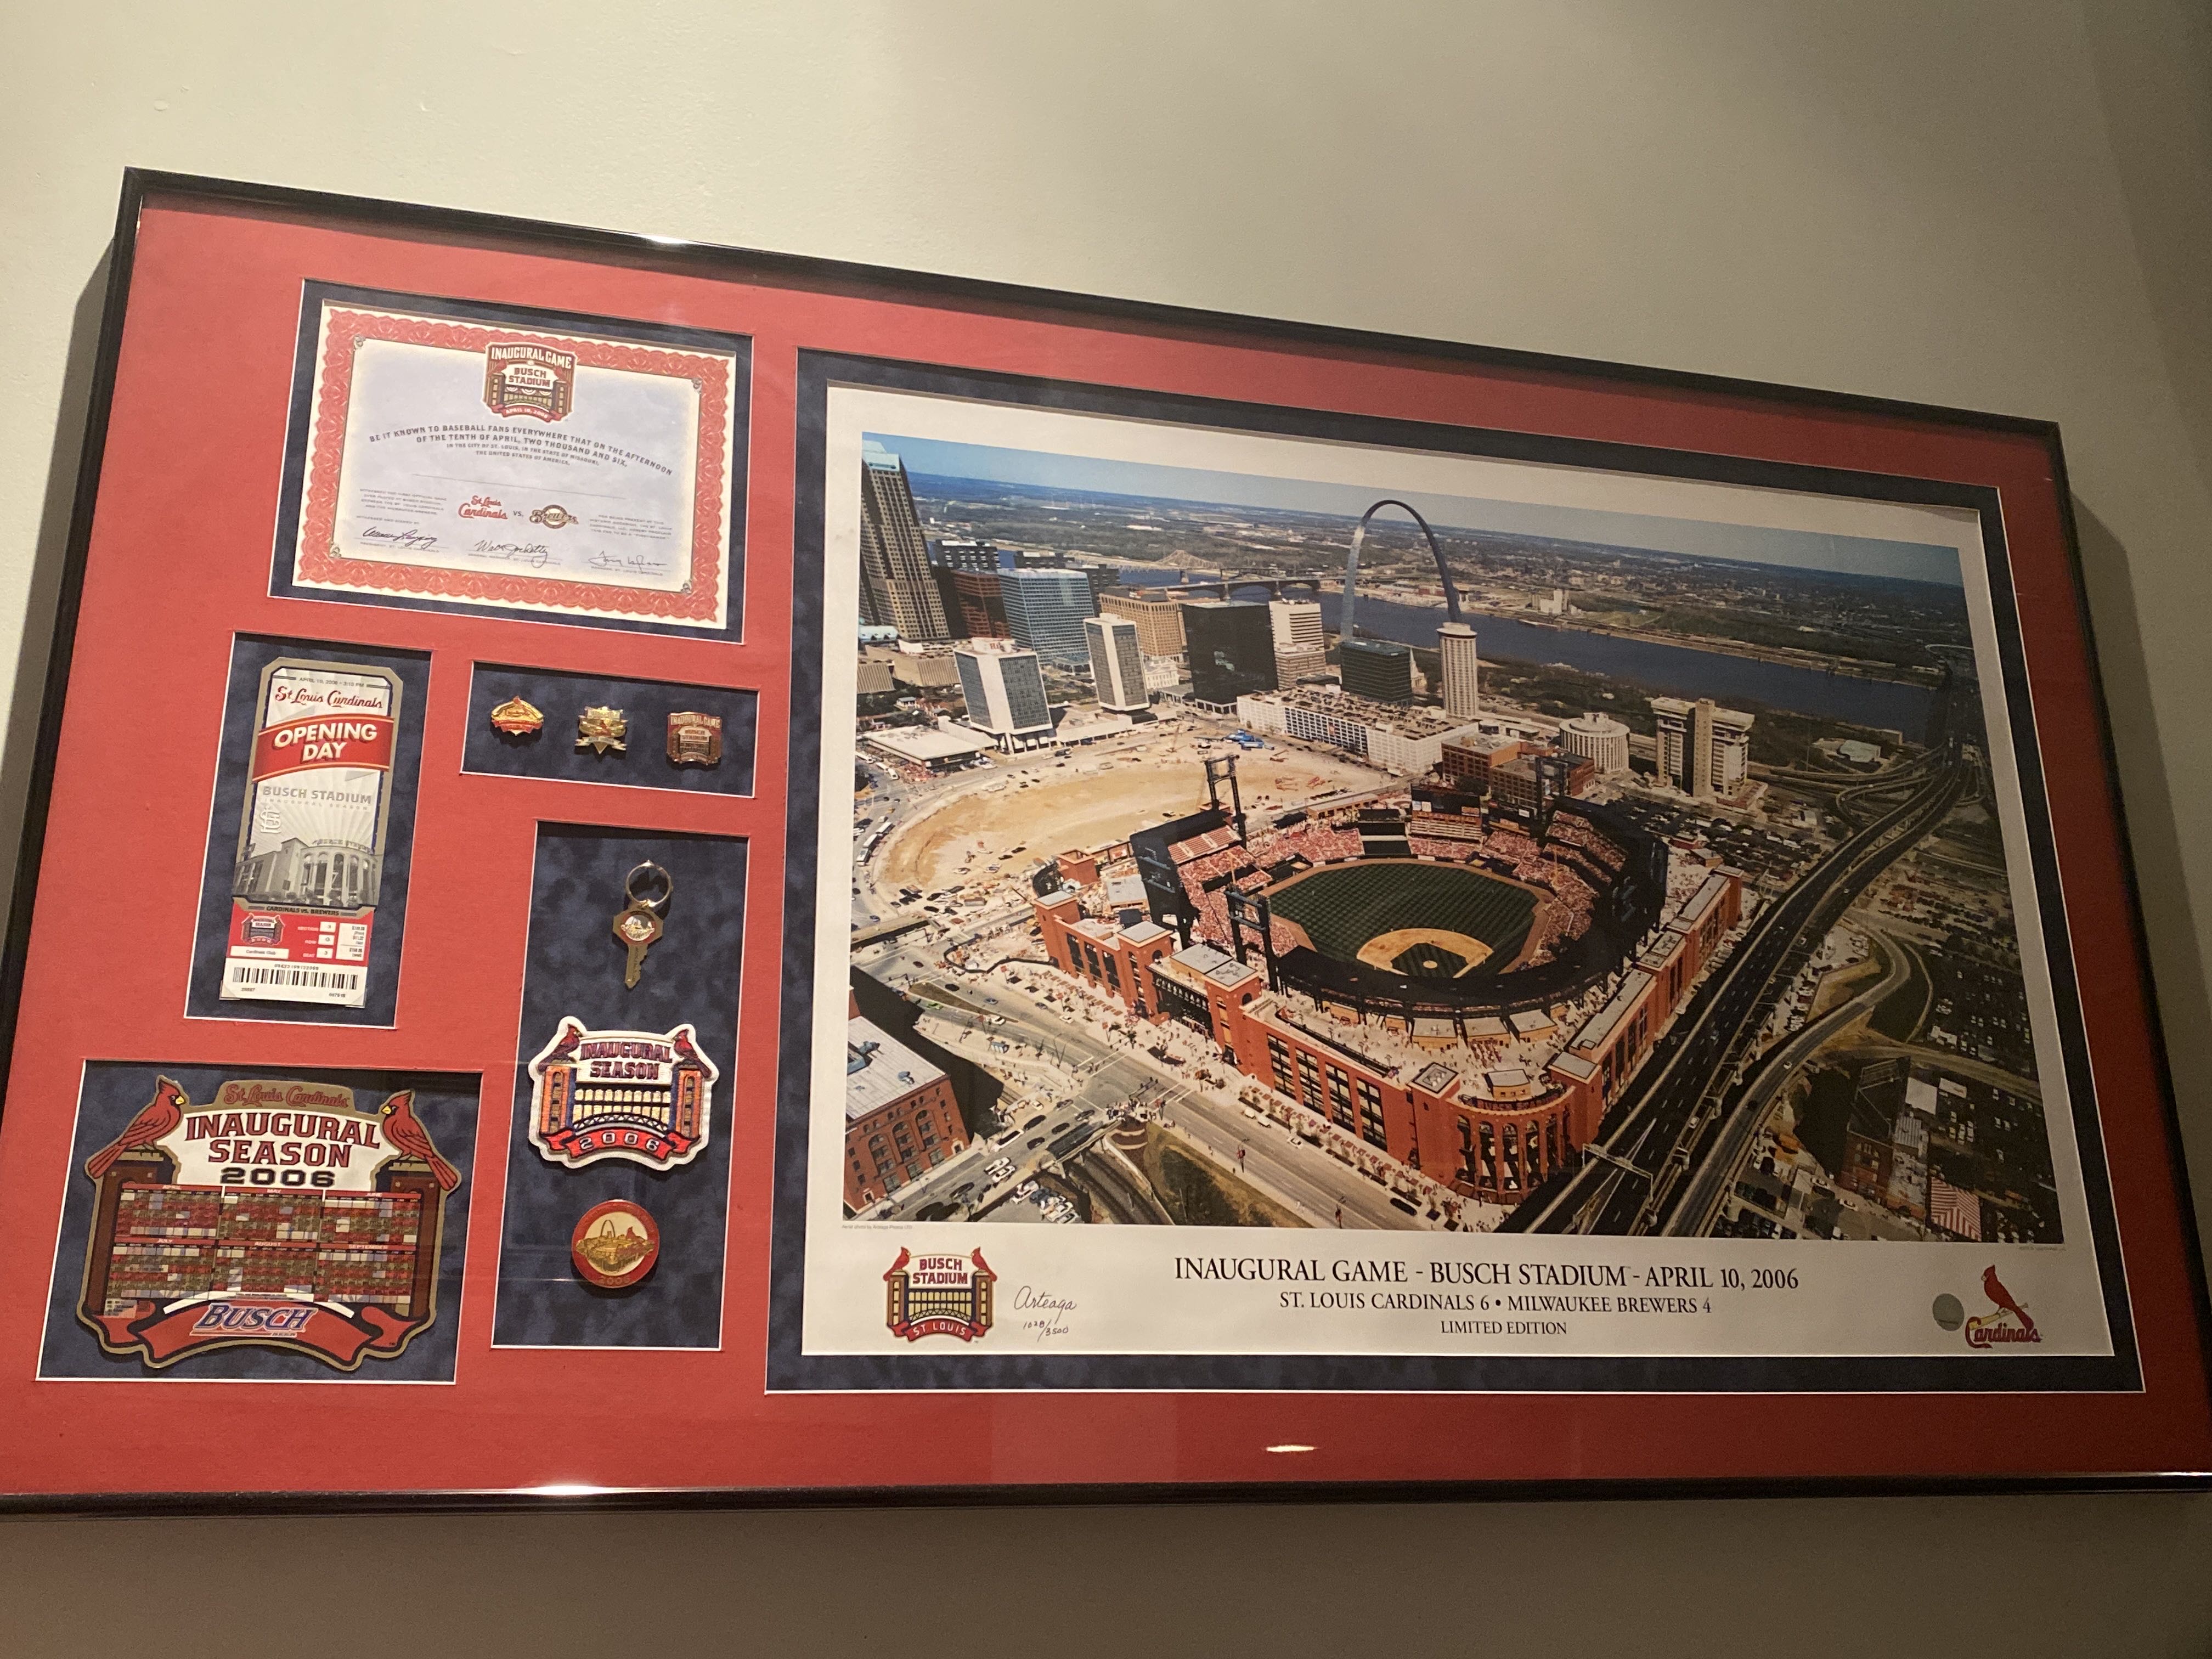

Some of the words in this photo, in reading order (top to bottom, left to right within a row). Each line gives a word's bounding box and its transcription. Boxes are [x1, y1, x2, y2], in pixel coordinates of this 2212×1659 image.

[492, 347, 544, 361] INAUGURAL
[546, 351, 572, 369] GAME
[509, 376, 550, 387] STADIUM
[514, 367, 546, 379] BUSCH
[369, 434, 380, 442] BE
[394, 427, 425, 437] KNOWN
[512, 427, 568, 441] EVERYWHERE
[571, 436, 591, 446] THAT
[608, 446, 624, 456] THE
[625, 452, 673, 476] AFTERNOON
[493, 435, 521, 444] APRIL,
[524, 437, 542, 445] TWO
[545, 441, 590, 455] THOUSAND
[592, 451, 610, 460] AND
[612, 456, 628, 467] SIX,
[458, 503, 508, 520] Cardinals
[481, 496, 501, 508] Louis
[529, 509, 579, 526] Brewers
[290, 689, 324, 706] Louis
[328, 690, 383, 709] Cardinals
[273, 723, 377, 748] OPENING
[301, 742, 347, 763] DAY
[263, 786, 307, 798] BUSCH
[312, 790, 371, 804] STADIUM
[265, 798, 323, 807] INAUGURAL
[579, 1042, 673, 1063] INAUGURAL
[590, 1061, 660, 1080] SEASON
[242, 1084, 284, 1107] Louis
[285, 1085, 349, 1107] Cardinals
[184, 1113, 381, 1149] INAUGURAL
[579, 1131, 659, 1151] 2006
[208, 1139, 353, 1167] SEASON
[221, 1167, 335, 1187] 2006
[919, 1257, 962, 1271] BUSCH
[1175, 1257, 1325, 1281] INAUGURAL
[1332, 1260, 1408, 1283] GAME
[1430, 1262, 1511, 1285] BUSCH
[1519, 1264, 1629, 1287] STADIUM
[1645, 1266, 1714, 1289] APRIL
[1720, 1268, 1746, 1290] 10,
[1751, 1268, 1799, 1289] 2006
[912, 1272, 968, 1285] STADIUM
[1014, 1285, 1077, 1324] Arteaga
[1280, 1291, 1304, 1308] ST.
[1311, 1293, 1365, 1309] LOUIS
[1371, 1293, 1475, 1311] CARDINALS
[1481, 1295, 1489, 1311] 6
[1508, 1295, 1612, 1313] MILWAUKEE
[1617, 1297, 1697, 1314] BREWERS
[1702, 1297, 1712, 1314] 4
[193, 1303, 316, 1331] BUSCH
[913, 1324, 926, 1336] ST
[933, 1321, 967, 1336] LOUIS
[1441, 1321, 1503, 1335] LIMITED
[1507, 1321, 1567, 1335] EDITION
[1965, 1316, 2043, 1349] Cardinals
